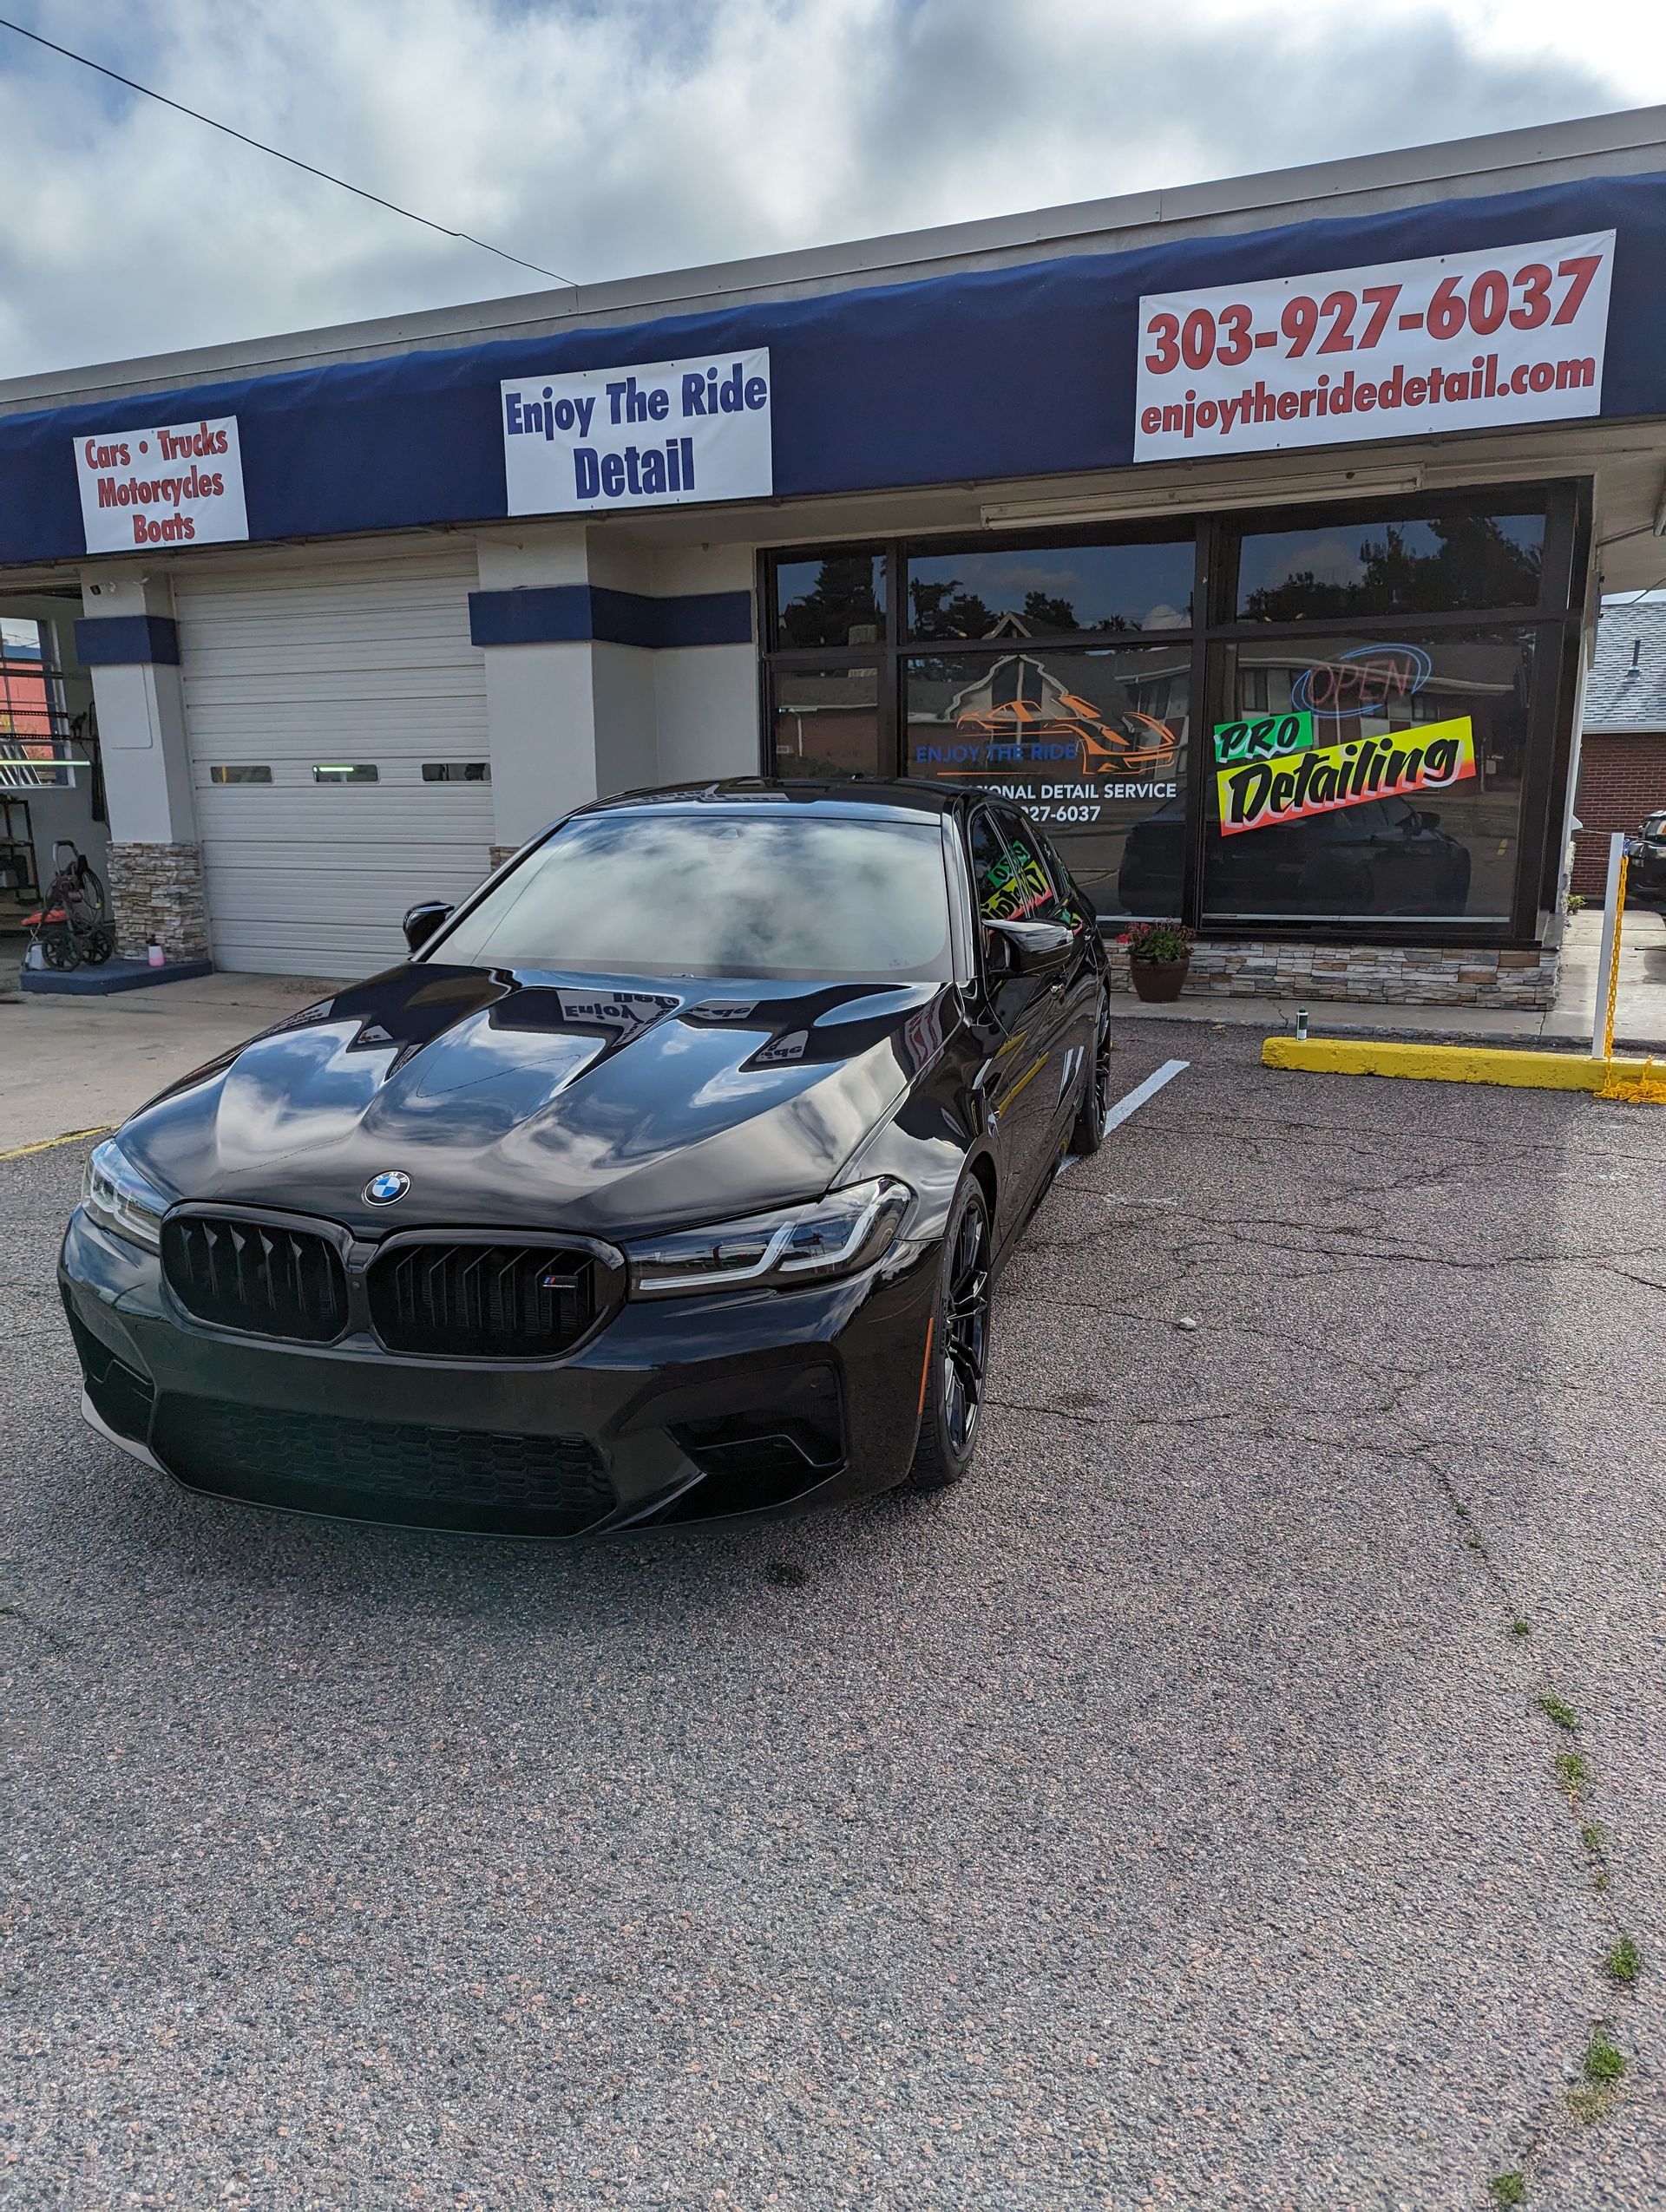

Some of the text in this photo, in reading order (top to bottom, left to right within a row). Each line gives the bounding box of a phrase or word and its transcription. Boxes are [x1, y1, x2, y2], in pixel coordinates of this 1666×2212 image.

[1145, 254, 1604, 375] 303-927-6037
[505, 363, 767, 441] Enjoy The Ride
[1140, 354, 1595, 438] enjoytheridedetail.com
[85, 422, 228, 469] Cars Trucks
[574, 437, 694, 499] Detail
[97, 465, 224, 507] Motorcycles
[132, 513, 195, 544] Boats
[1308, 658, 1411, 705] OPEN
[916, 743, 1078, 763] ENJOY THE RIDE
[1214, 717, 1300, 762] PRO
[1041, 783, 1099, 799] DETAIL
[1104, 782, 1177, 798] SERVICE
[1225, 737, 1464, 828] Detailing
